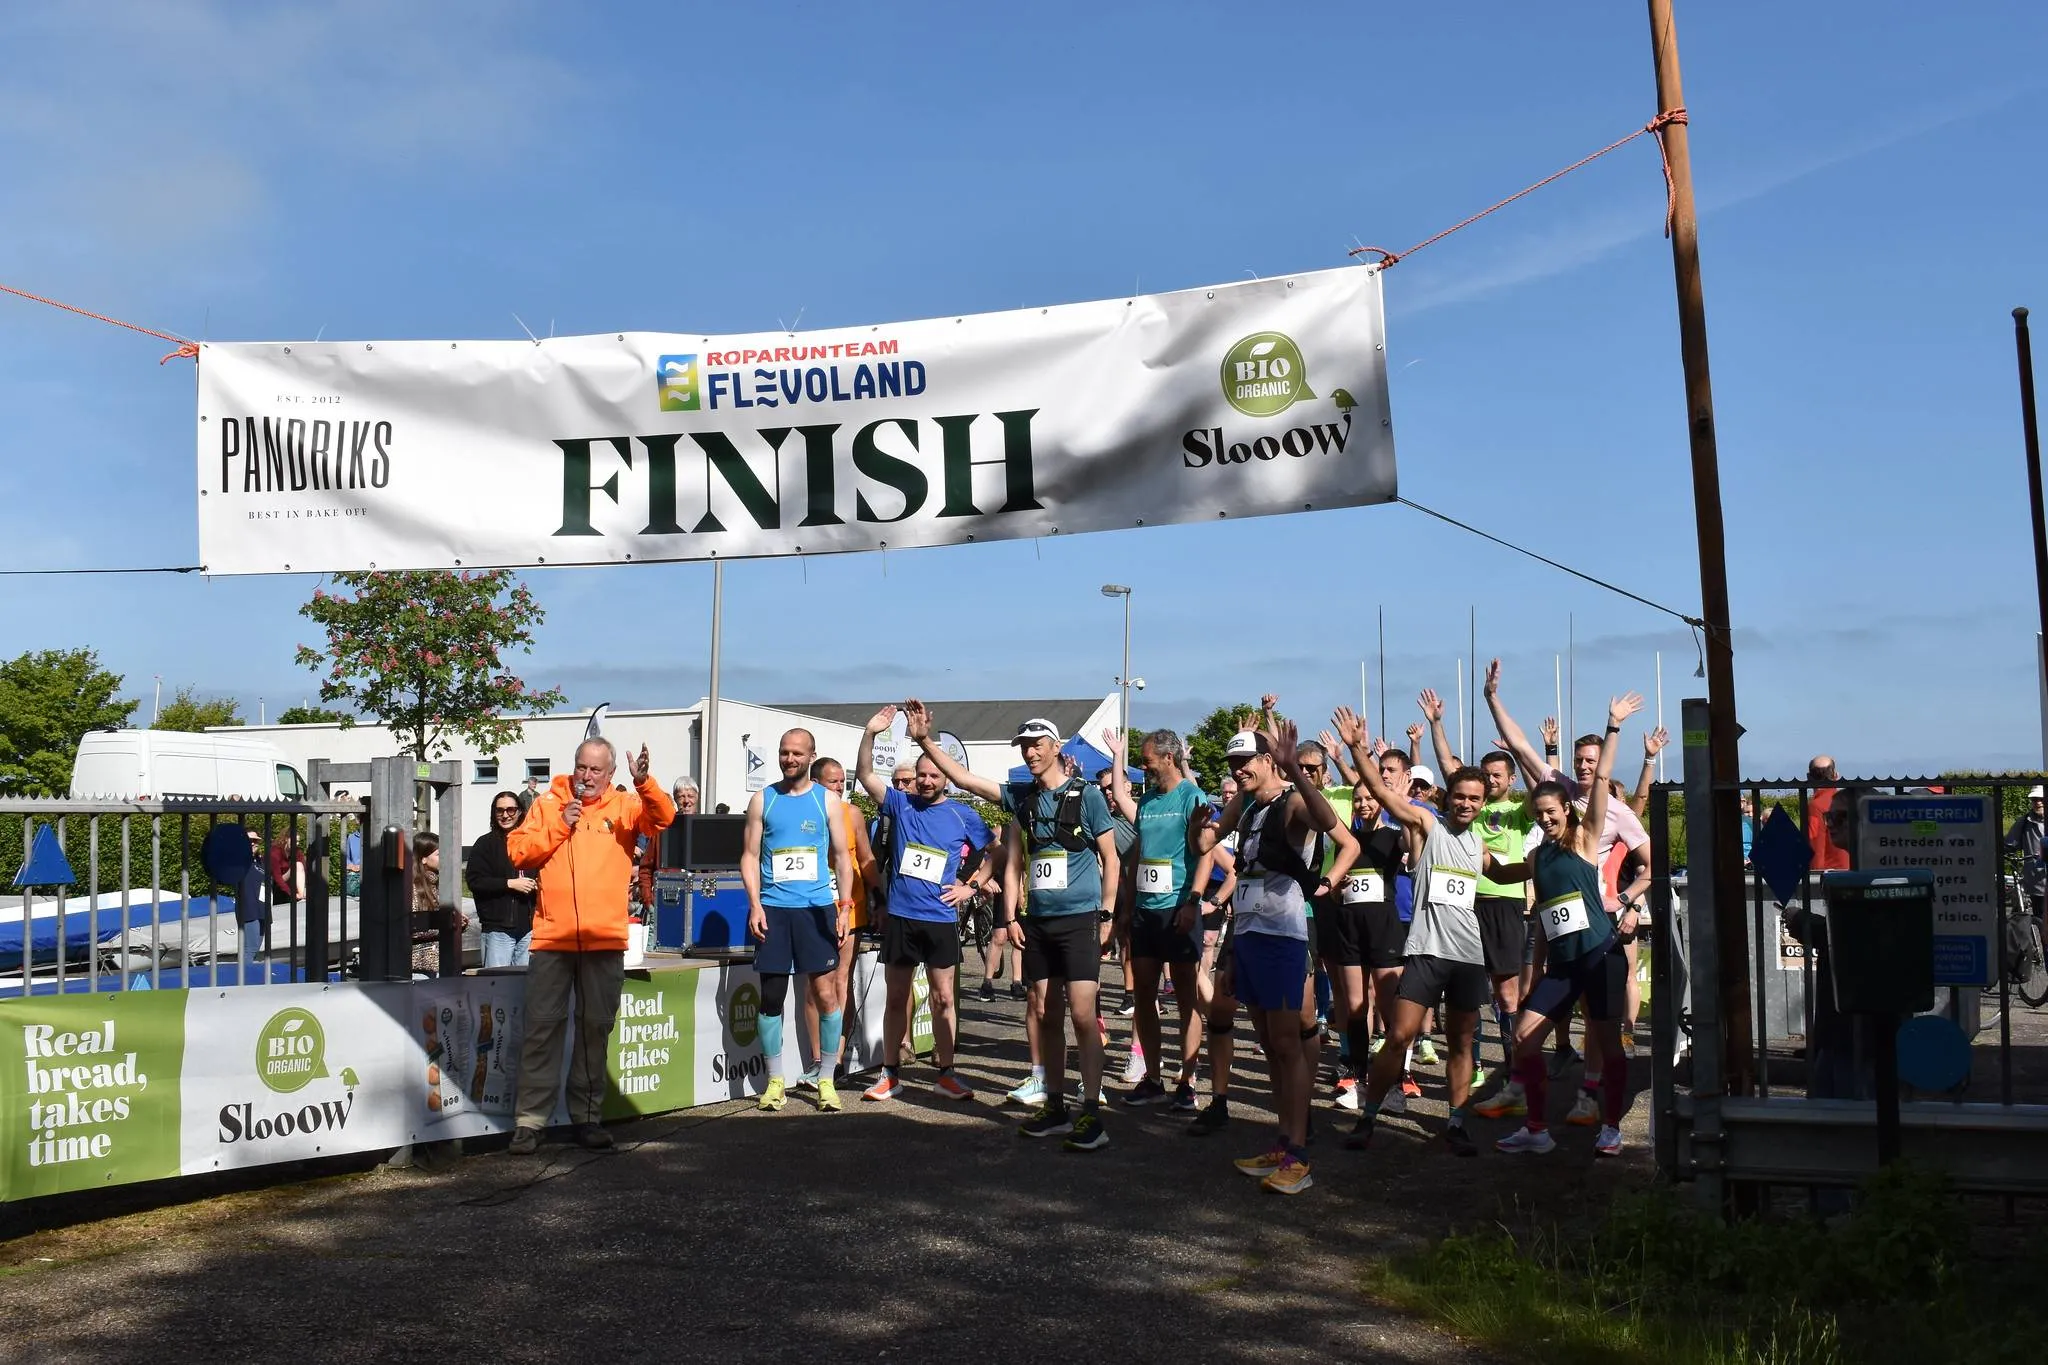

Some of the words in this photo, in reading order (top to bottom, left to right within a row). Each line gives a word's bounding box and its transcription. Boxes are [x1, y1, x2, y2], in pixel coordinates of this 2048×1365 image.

[707, 339, 899, 366] ROPARUNTEAM
[1234, 357, 1291, 381] BIO
[707, 361, 926, 409] FLEVOLAND
[1236, 380, 1291, 399] ORGANIC
[276, 395, 307, 404] EST.
[311, 394, 342, 404] 2012
[221, 415, 393, 493] PANDRIKS
[551, 408, 1045, 537] FINISH
[248, 511, 281, 520] BEST
[285, 510, 299, 519] IN
[306, 508, 340, 519] BAKE
[344, 507, 368, 517] OFF
[1873, 808, 1978, 820] PRIVETERREIN
[1880, 837, 1944, 848] Betreden
[1949, 838, 1975, 848] van
[785, 856, 805, 871] 25
[912, 853, 932, 870] 31
[1035, 862, 1052, 878] 30
[1879, 855, 1898, 866] dit
[1904, 856, 1953, 866] terrein
[1958, 857, 1975, 866] en
[1143, 868, 1158, 883] 19
[1351, 878, 1370, 893] 85
[1446, 878, 1465, 896] 63
[1942, 893, 1988, 905] geheel
[1551, 907, 1570, 926] 89
[1937, 911, 1982, 922] risico.
[619, 991, 663, 1018] Real
[734, 1003, 757, 1020] BIO
[22, 1019, 115, 1058] Real
[618, 1015, 679, 1046] bread,
[267, 1035, 315, 1057] BIO
[266, 1057, 312, 1075] ORGANIC
[618, 1043, 670, 1071] takes
[25, 1052, 148, 1094] bread,
[618, 1070, 661, 1096] time
[28, 1091, 130, 1131] takes
[28, 1129, 112, 1167] time
